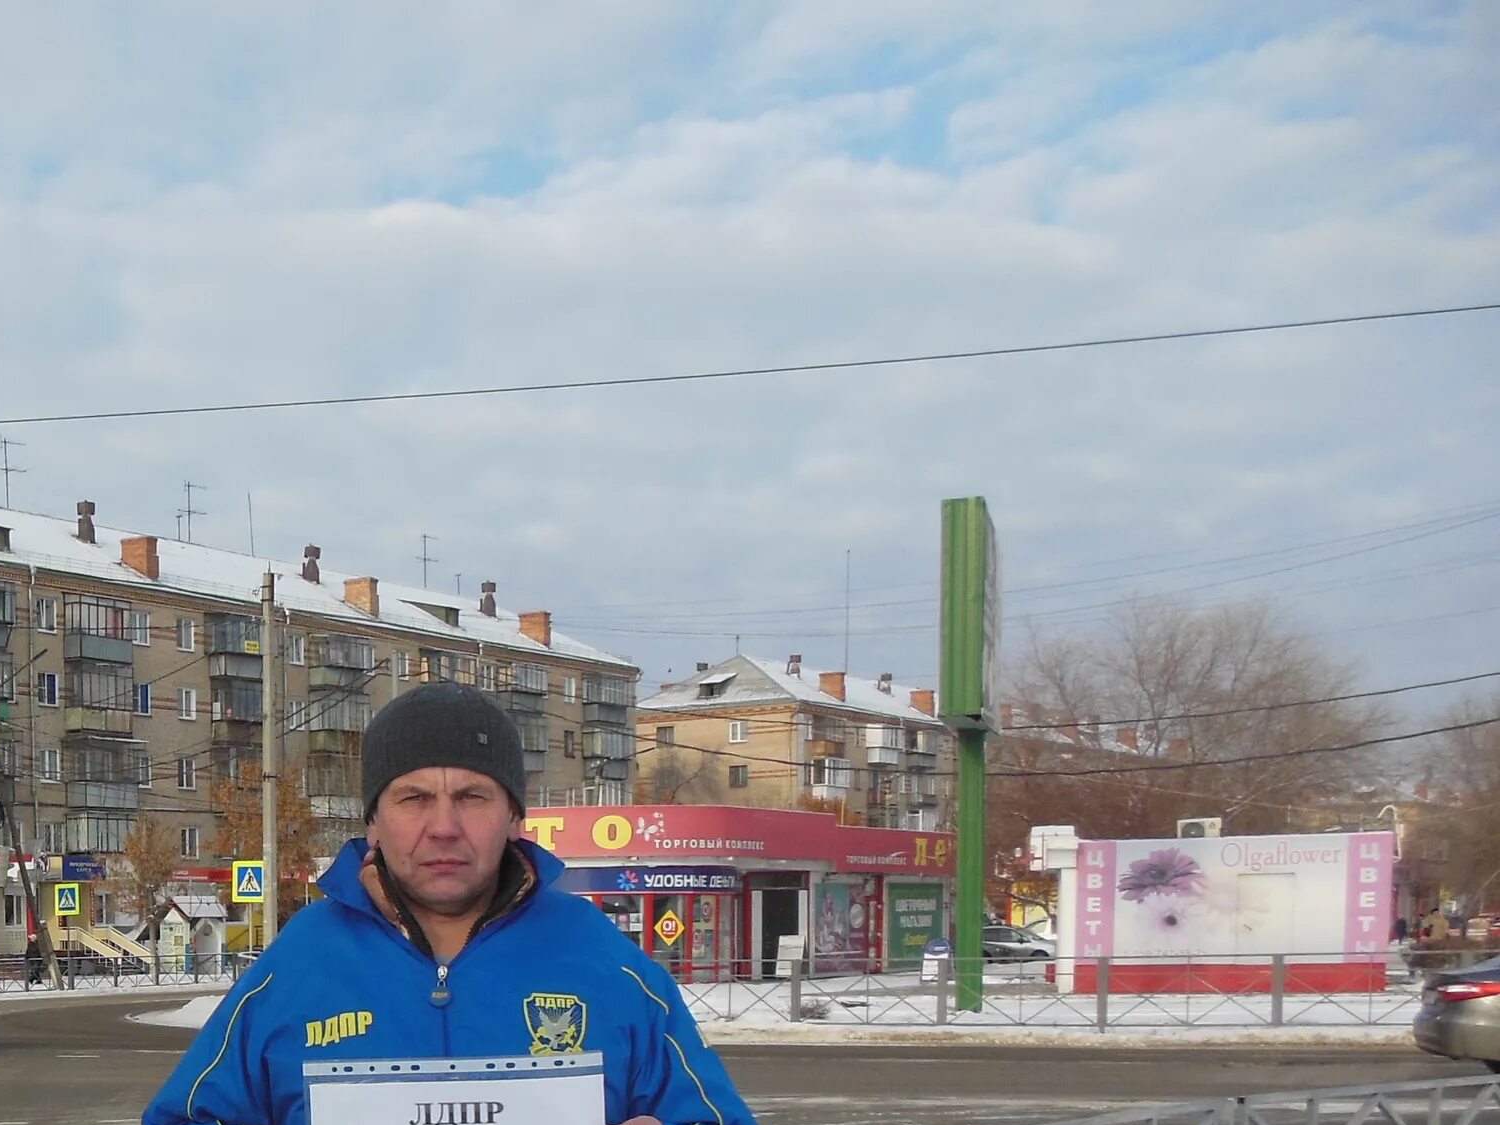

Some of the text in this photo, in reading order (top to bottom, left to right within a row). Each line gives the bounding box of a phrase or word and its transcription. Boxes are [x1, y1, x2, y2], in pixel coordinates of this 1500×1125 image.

[654, 837, 765, 851] ТОРГОВЫЙ КОМПЛЕКС
[1220, 841, 1342, 871] Olgaflower
[644, 874, 707, 888] УДОБНЫЕ
[1083, 850, 1104, 957] ЦВЕТЫ
[1357, 843, 1380, 954] ЦВЕТЫ
[535, 995, 577, 1009] ЛДПР
[304, 1010, 374, 1048] ЛДПР
